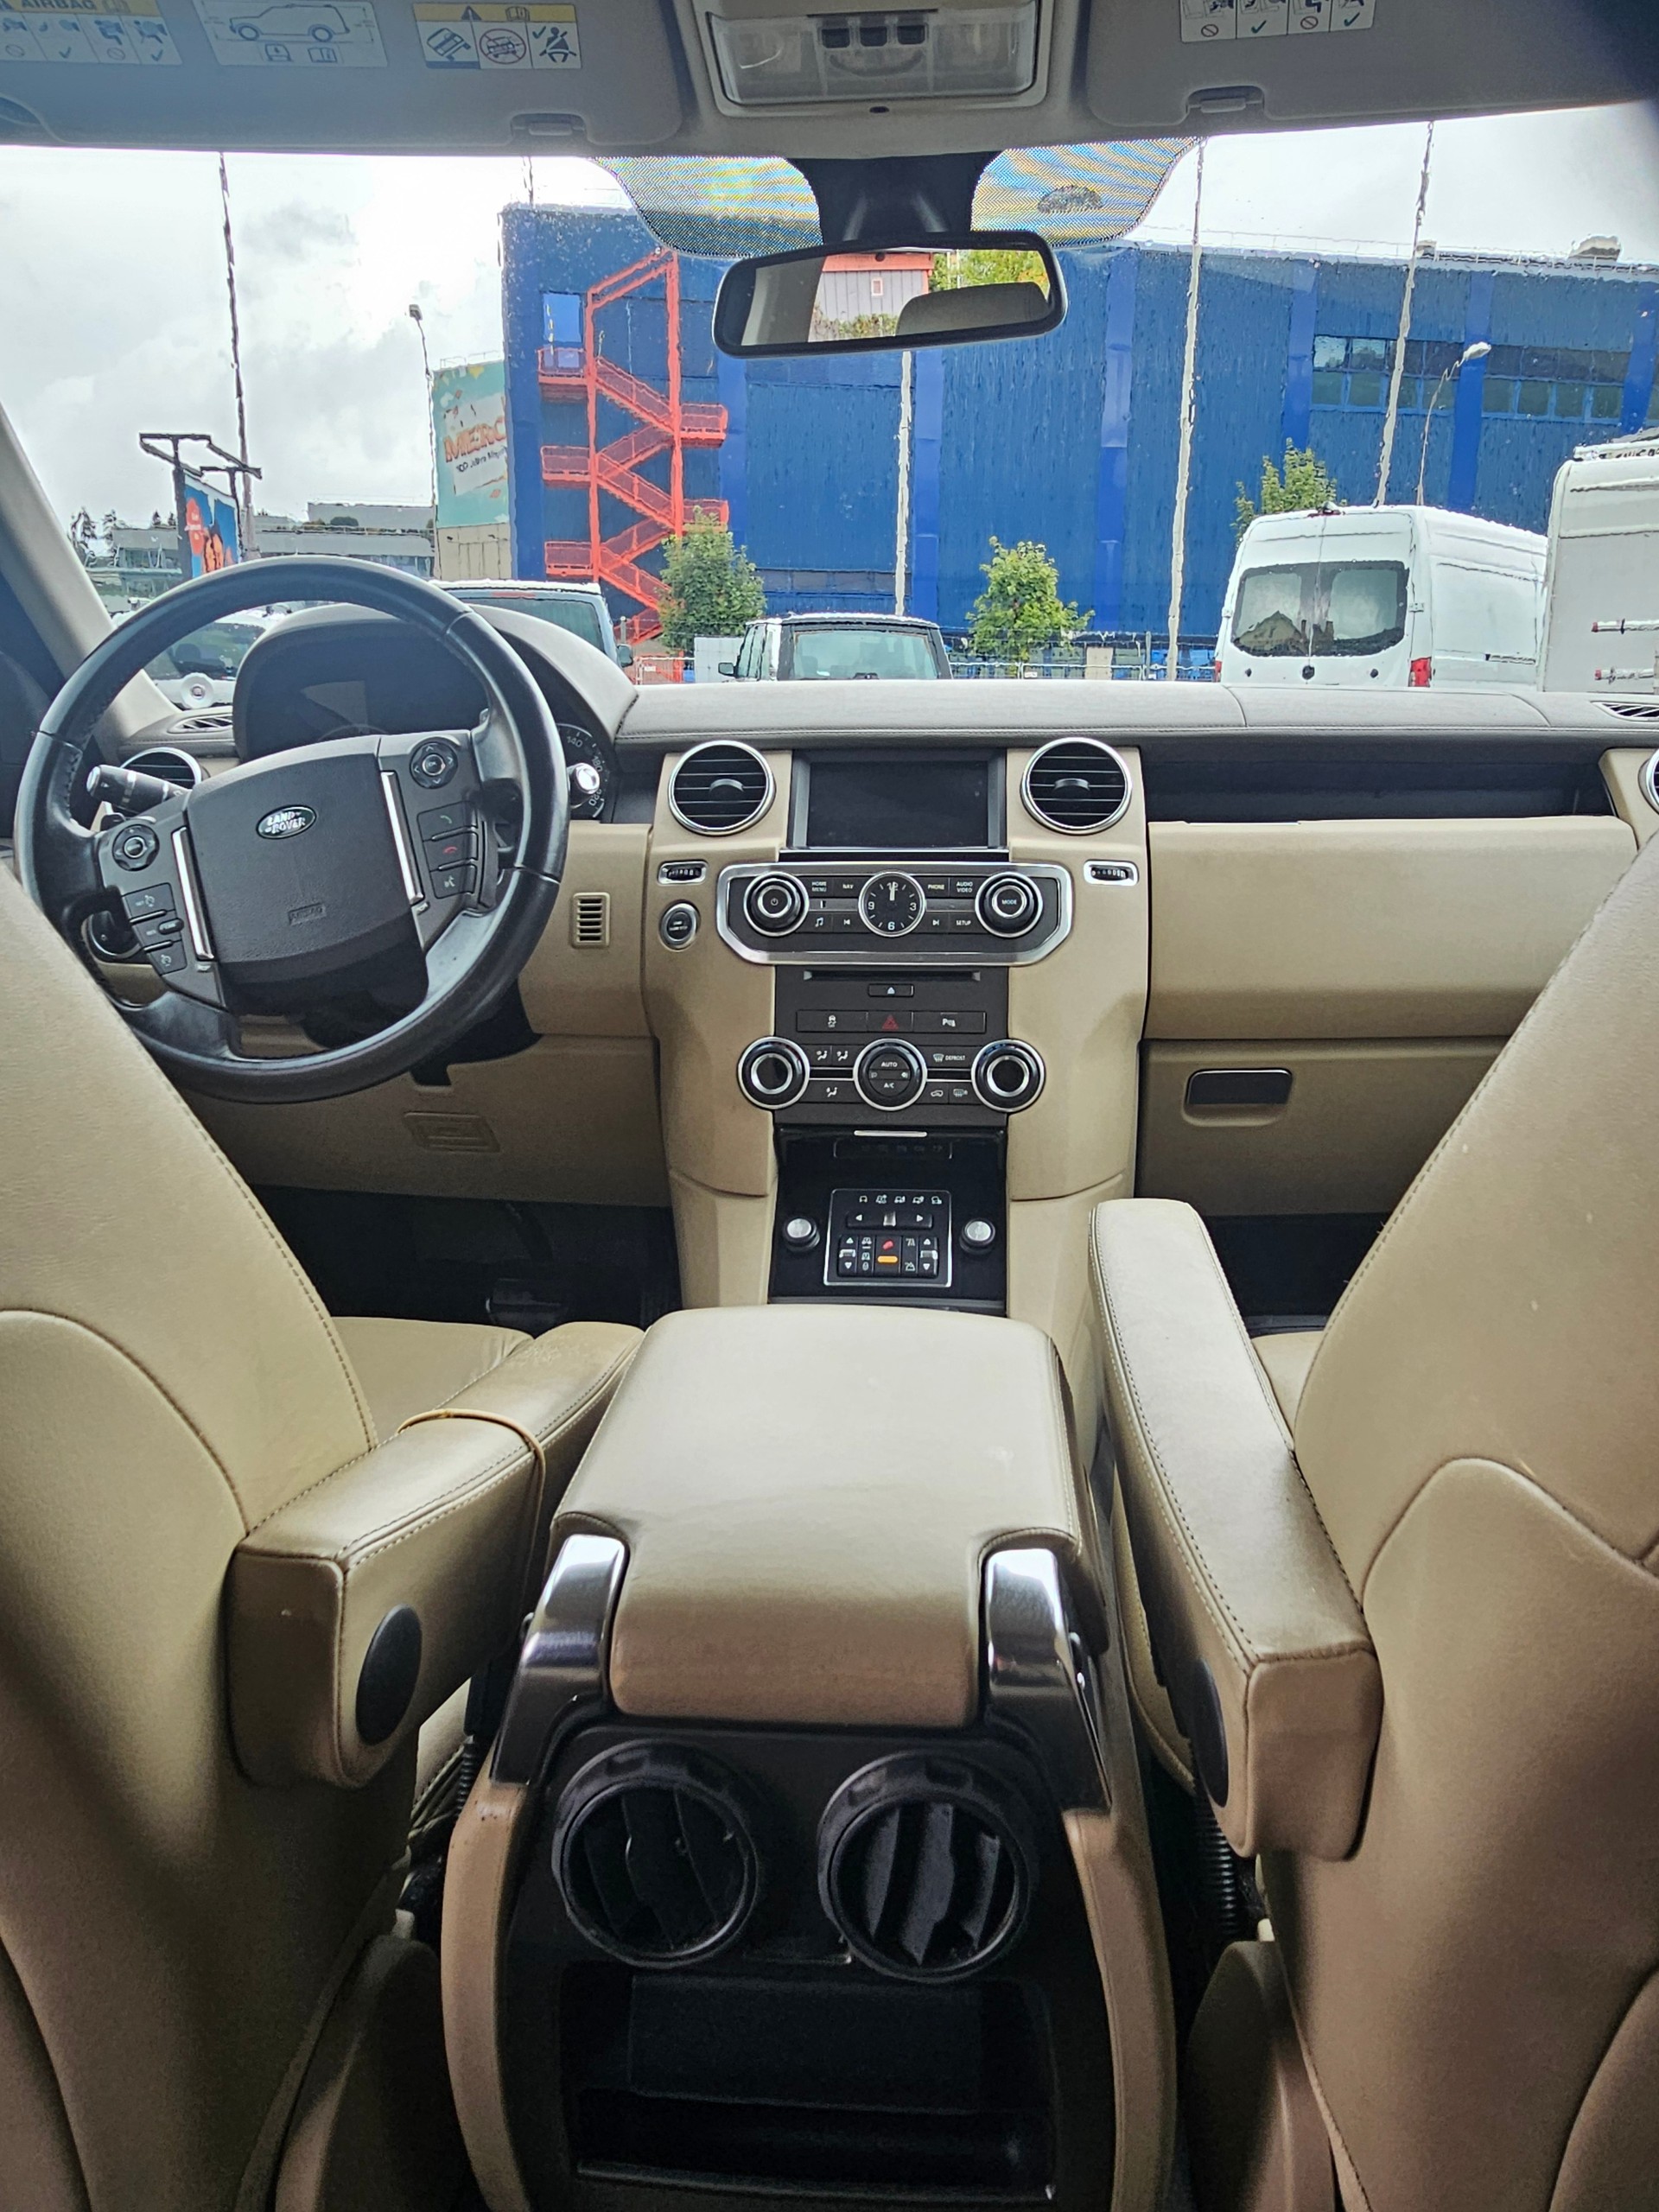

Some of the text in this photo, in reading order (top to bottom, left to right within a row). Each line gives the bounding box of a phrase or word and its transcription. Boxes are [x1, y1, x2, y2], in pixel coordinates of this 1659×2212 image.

[567, 736, 583, 747] 140
[592, 756, 603, 772] 180
[271, 817, 305, 834] ROVER
[868, 901, 874, 910] 9
[909, 902, 917, 911] 3
[887, 921, 895, 931] 6
